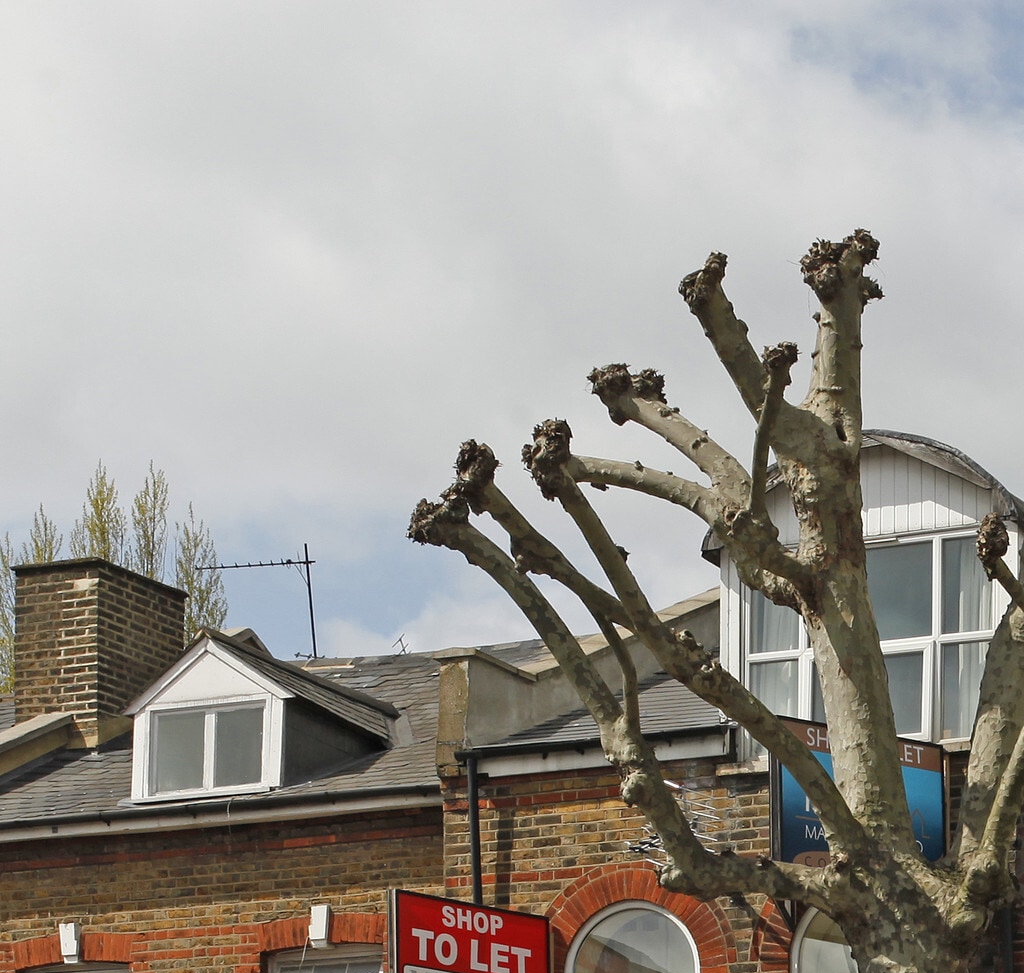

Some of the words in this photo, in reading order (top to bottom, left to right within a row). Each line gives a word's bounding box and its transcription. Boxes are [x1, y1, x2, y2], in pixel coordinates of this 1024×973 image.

[806, 728, 829, 748] SH
[900, 744, 924, 764] ET
[442, 905, 504, 936] SHOP
[412, 928, 458, 966] TO
